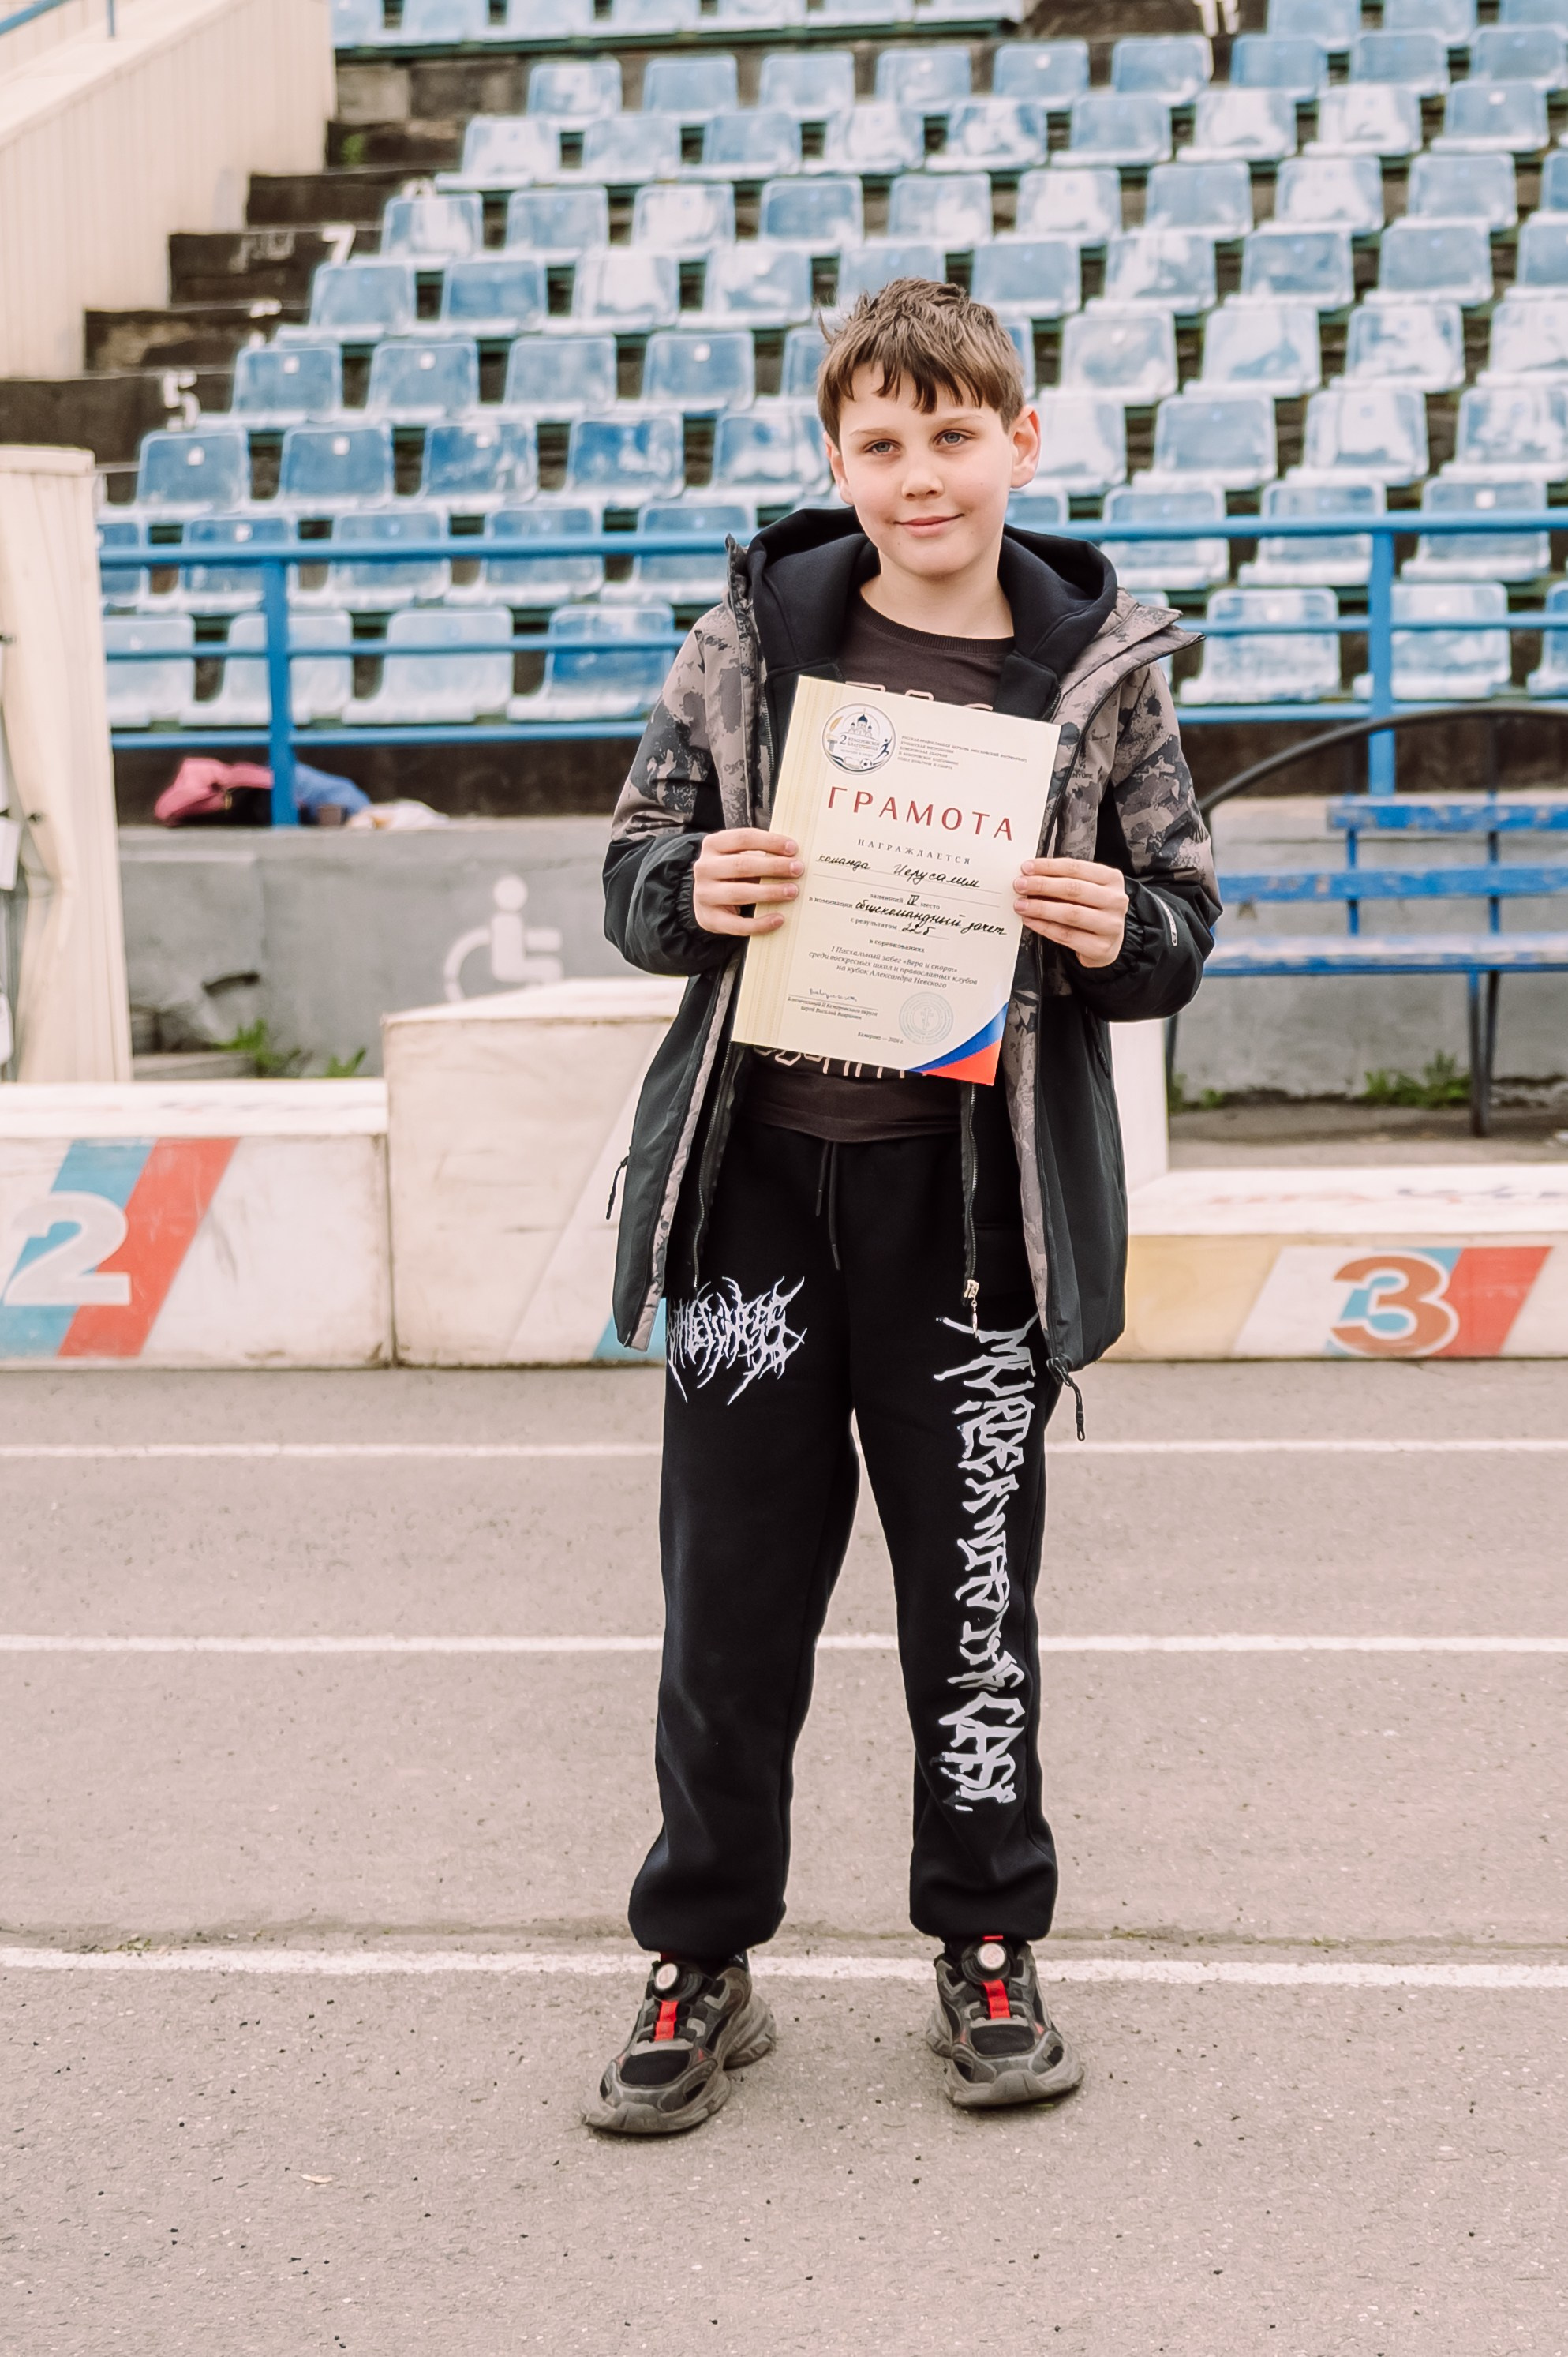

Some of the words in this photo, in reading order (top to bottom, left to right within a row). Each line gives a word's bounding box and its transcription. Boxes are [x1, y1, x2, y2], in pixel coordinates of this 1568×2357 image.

[828, 786, 1012, 841] ГРАМОТА
[817, 854, 871, 871] команда
[858, 838, 971, 865] НАГРАЖДАЕТСЯ
[814, 897, 853, 909] номинации
[855, 918, 897, 931] результатом
[836, 946, 881, 961] Пасхальный
[882, 955, 902, 964] забег
[874, 940, 925, 953] соревнованиях
[809, 951, 829, 960] среди
[829, 955, 871, 967] воскресных
[952, 975, 978, 985] клубов
[847, 966, 868, 976] кубок
[870, 969, 912, 984] Александра
[914, 977, 947, 989] Невского
[3, 1191, 132, 1306] 2
[1327, 1251, 1460, 1357] 3
